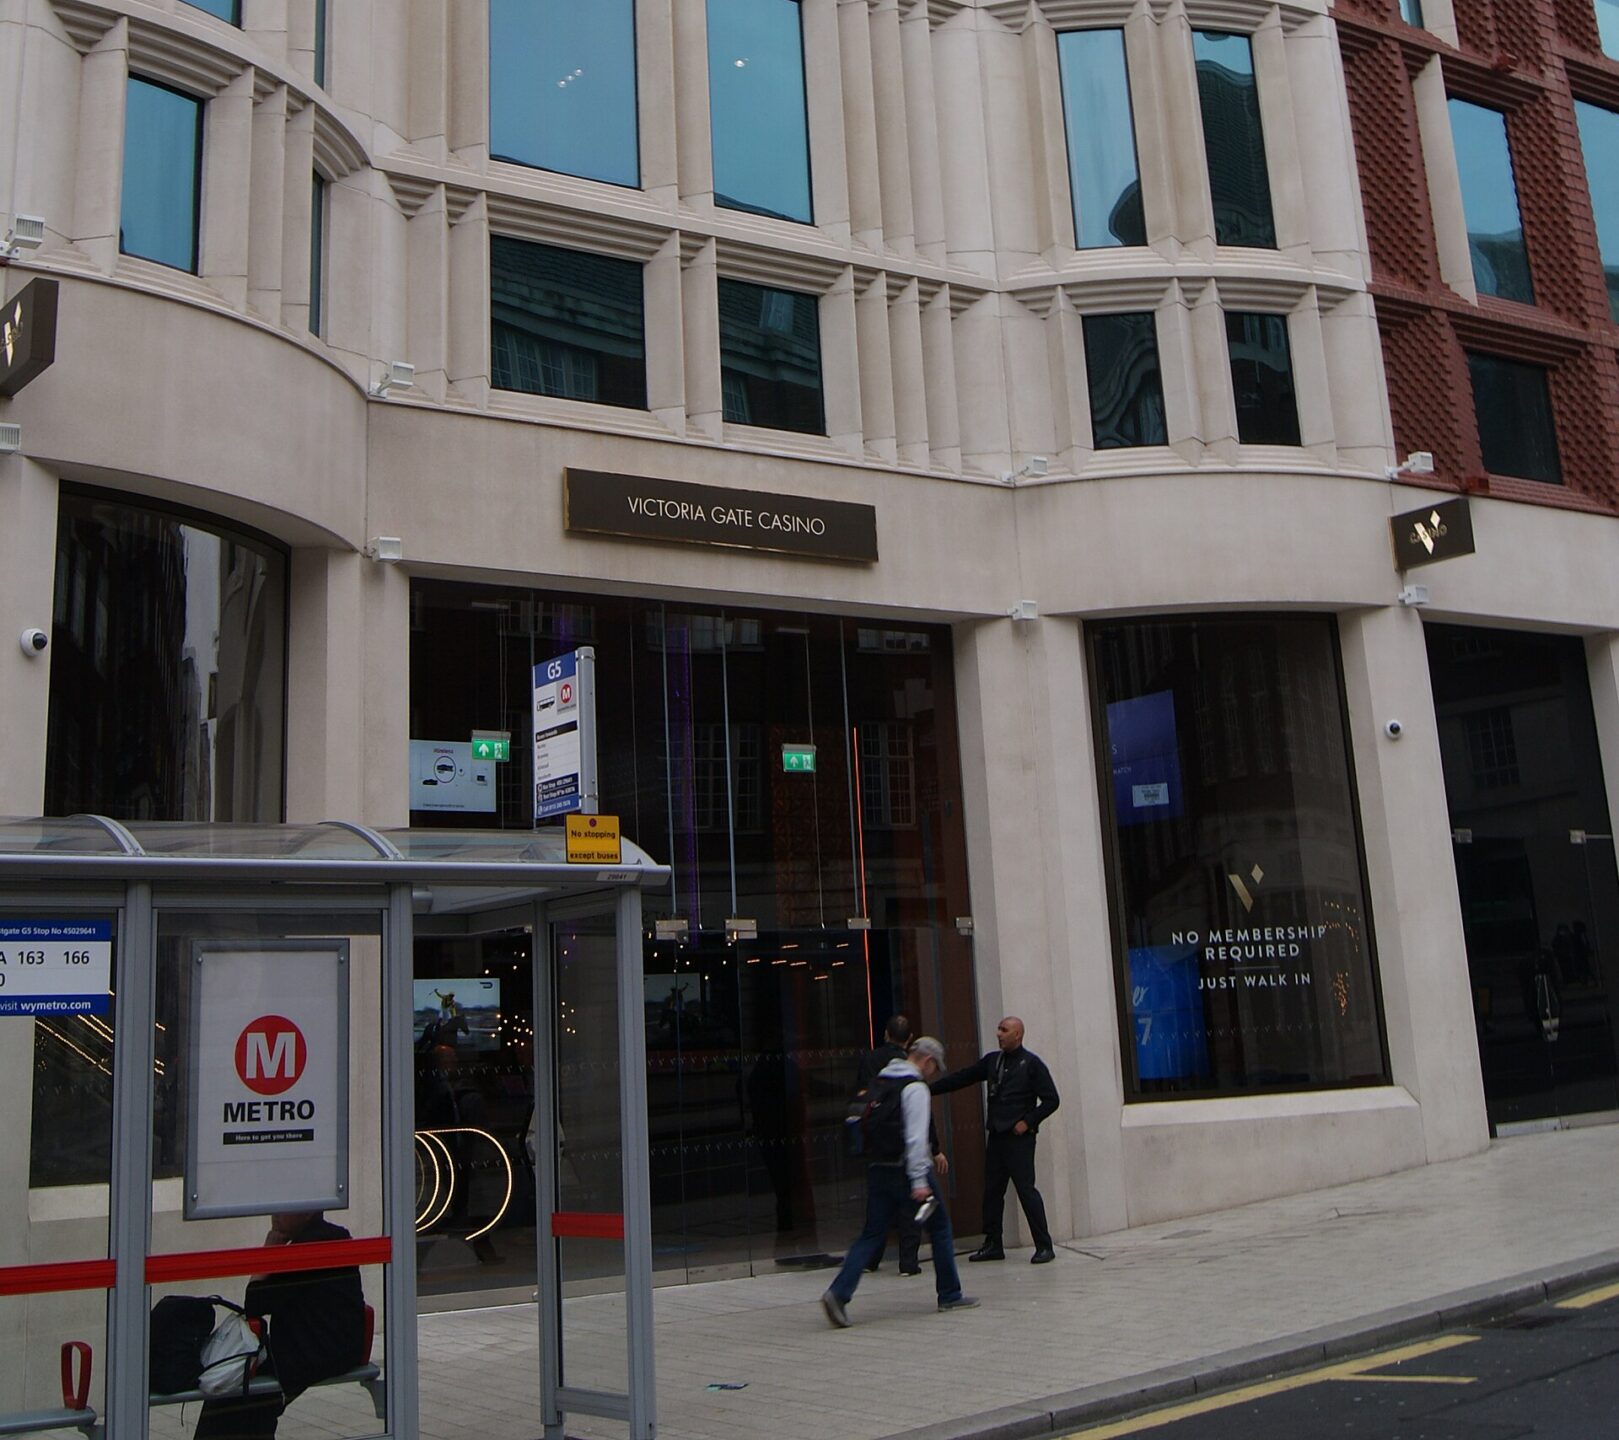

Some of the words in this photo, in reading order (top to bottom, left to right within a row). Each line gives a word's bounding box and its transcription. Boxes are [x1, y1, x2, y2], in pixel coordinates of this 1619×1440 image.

[627, 496, 707, 522] VICTORIA
[711, 506, 753, 528] GATE
[758, 511, 826, 535] CASINO
[547, 660, 562, 680] G5
[571, 830, 582, 838] No
[584, 831, 616, 840] stopping
[570, 852, 595, 860] except
[597, 851, 618, 859] buses
[21, 927, 32, 935] G5
[33, 927, 50, 936] Stop
[51, 927, 62, 935] No
[1172, 931, 1200, 946] NO
[1209, 925, 1326, 944] MEMBERSHIP
[18, 951, 45, 965] 163
[63, 951, 90, 965] 166
[1205, 944, 1300, 962] REQUIRED
[1198, 976, 1237, 990] JUST
[1244, 973, 1288, 988] WALK
[1295, 972, 1312, 985] IN
[0, 1001, 18, 1011] visit
[20, 1000, 91, 1013] wymetro.com
[245, 1031, 296, 1079] M
[223, 1099, 315, 1123] METRO
